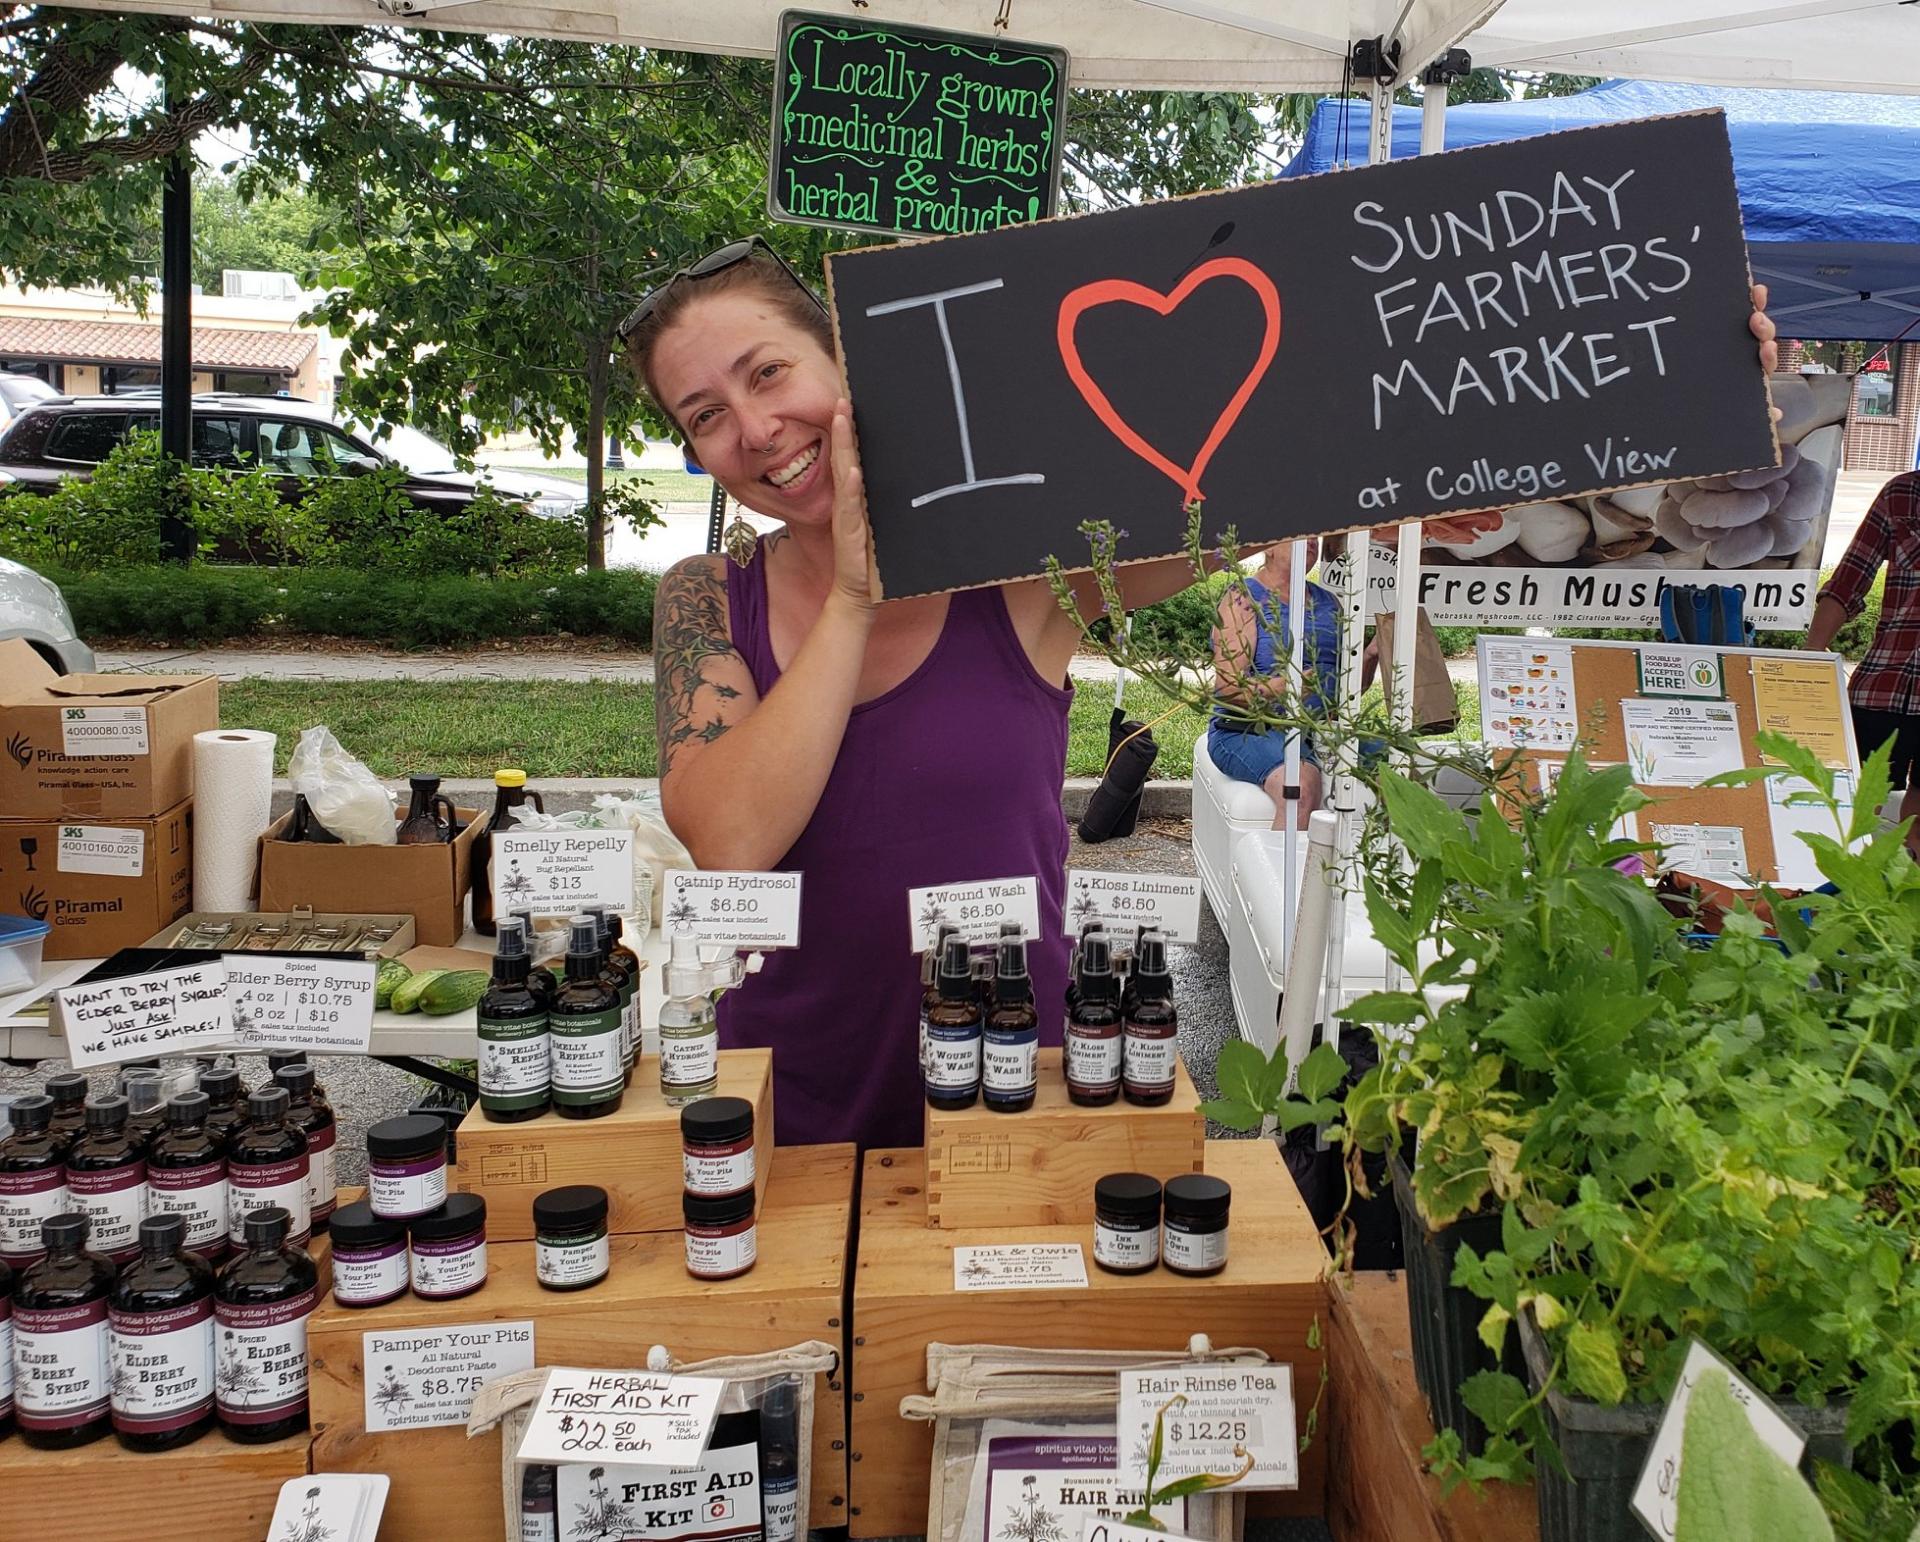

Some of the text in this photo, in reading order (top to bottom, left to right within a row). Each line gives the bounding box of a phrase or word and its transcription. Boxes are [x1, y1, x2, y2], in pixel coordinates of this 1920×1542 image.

[812, 40, 1038, 122] Locally grown
[796, 104, 1038, 176] medicinal herbs
[896, 160, 938, 195] &
[785, 169, 1039, 233] herbal products!
[1351, 169, 1634, 273] SUNDAY
[1375, 225, 1700, 347] FARMERS'
[1372, 316, 1675, 431] MARKET
[866, 278, 1045, 507] I
[1358, 437, 1676, 509] at College View
[1419, 573, 1538, 606] Fresh
[1433, 612, 1473, 620] Nebraska
[1644, 668, 1684, 676] ACCEPTED
[1645, 676, 1686, 689] HERE!
[66, 709, 86, 719] SKS
[1668, 707, 1691, 715] 2019
[67, 726, 142, 735] 40000080.03S
[38, 767, 80, 775] knowledge
[64, 827, 83, 838] SKS
[62, 841, 138, 854] 40010160.02S
[504, 837, 626, 854] Smelly Repelly
[554, 864, 594, 873] Repellant
[549, 877, 582, 890] $13
[674, 876, 796, 891] Catnip Hydrosol
[1091, 879, 1195, 895] Kloss Liniment
[936, 884, 1026, 903] Wound Wash
[55, 898, 122, 914] Piramal
[553, 904, 576, 912] vitae
[710, 898, 758, 912] $6.50
[1112, 896, 1156, 910] $6.50
[960, 903, 1004, 919] $6.50
[55, 916, 87, 926] Glass
[739, 933, 786, 941] botanicals
[285, 963, 316, 972] Spiced
[228, 972, 371, 992] Elder Berry Syrup
[64, 972, 202, 1007] WANT TO TRY THE
[77, 983, 228, 1020] ELDER BERRY SYRUP?
[243, 990, 352, 1006] 4 oz $10.75
[254, 1007, 339, 1022] 8 oz $16
[297, 1024, 329, 1032] included
[83, 1017, 220, 1053] WE HAVE SAMPLES!
[249, 1034, 287, 1042] spiritus
[315, 1036, 363, 1045] botanicals
[499, 1043, 542, 1056] SMELLY
[674, 1044, 704, 1052] CATNIP
[1070, 1049, 1107, 1058] LINIMENT
[1128, 1050, 1166, 1058] LINIMENT
[560, 1050, 605, 1060] REPELLY
[937, 1051, 972, 1060] WOUND
[986, 1052, 1019, 1063] WOUND
[946, 1061, 974, 1071] WASH
[993, 1065, 1022, 1075] WASH
[699, 1159, 730, 1168] Pamper
[163, 1201, 197, 1212] ELDER
[243, 1198, 276, 1209] ELDER
[96, 1225, 131, 1239] SYRUP
[563, 1245, 593, 1255] Pamper
[1032, 1247, 1078, 1255] Owie
[440, 1252, 473, 1264] Pamper
[345, 1263, 378, 1271] Pamper
[372, 1329, 529, 1353] Pamper Your Pits
[21, 1349, 58, 1364] ELDER
[247, 1343, 292, 1359] ELDER
[422, 1350, 482, 1363] All Natural
[126, 1354, 168, 1367] ELDER
[262, 1352, 305, 1373] BERRY
[32, 1367, 76, 1380] BERRY
[139, 1366, 186, 1383] BERRY
[407, 1361, 497, 1375] Deodorant Paste
[45, 1380, 90, 1396] SYRUP
[154, 1378, 198, 1398] SYRUP
[422, 1376, 484, 1397] $8.75
[589, 1376, 668, 1393] HERBAL
[1137, 1375, 1276, 1394] Hair Rinse Tea
[551, 1388, 699, 1409] FIRST AID KIT
[1202, 1398, 1218, 1406] and
[1220, 1397, 1253, 1406] nourish
[1255, 1396, 1272, 1405] dry,
[414, 1402, 436, 1410] sales
[1200, 1408, 1236, 1417] thinning
[1238, 1408, 1256, 1416] hair
[387, 1412, 459, 1426] spiritus vitae
[667, 1432, 700, 1441] included
[615, 1440, 652, 1451] each
[1035, 1444, 1071, 1454] spiritus
[1168, 1448, 1190, 1456] sales
[1061, 1456, 1097, 1464] apothecary
[1159, 1463, 1231, 1476] spiritus vitae
[622, 1471, 754, 1503] FIRST AID
[1059, 1488, 1108, 1505] HAIR
[645, 1509, 694, 1528] KIT
